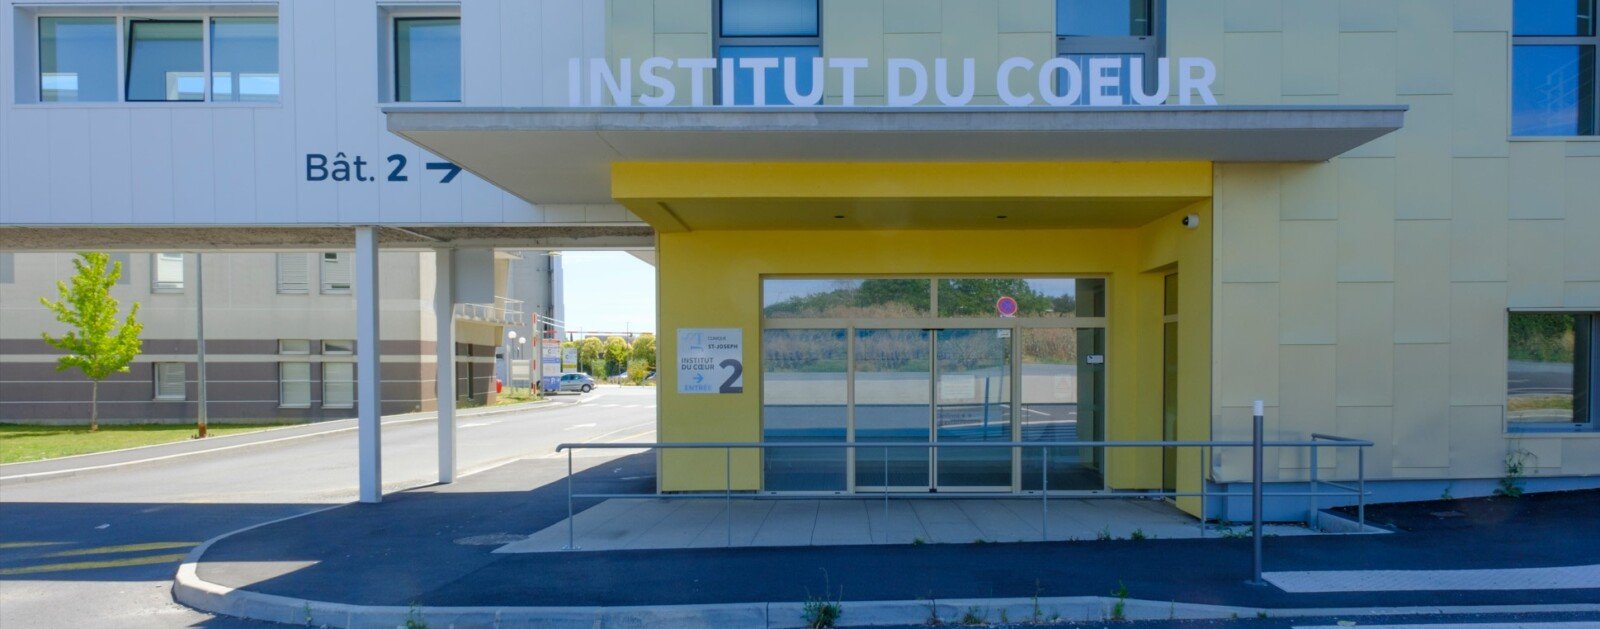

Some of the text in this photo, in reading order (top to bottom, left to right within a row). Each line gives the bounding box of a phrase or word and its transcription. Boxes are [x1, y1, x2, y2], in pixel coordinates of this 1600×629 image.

[568, 57, 1217, 106] INSTITUT DU COEUR
[306, 152, 408, 182] Bât. 2
[719, 358, 743, 394] 2
